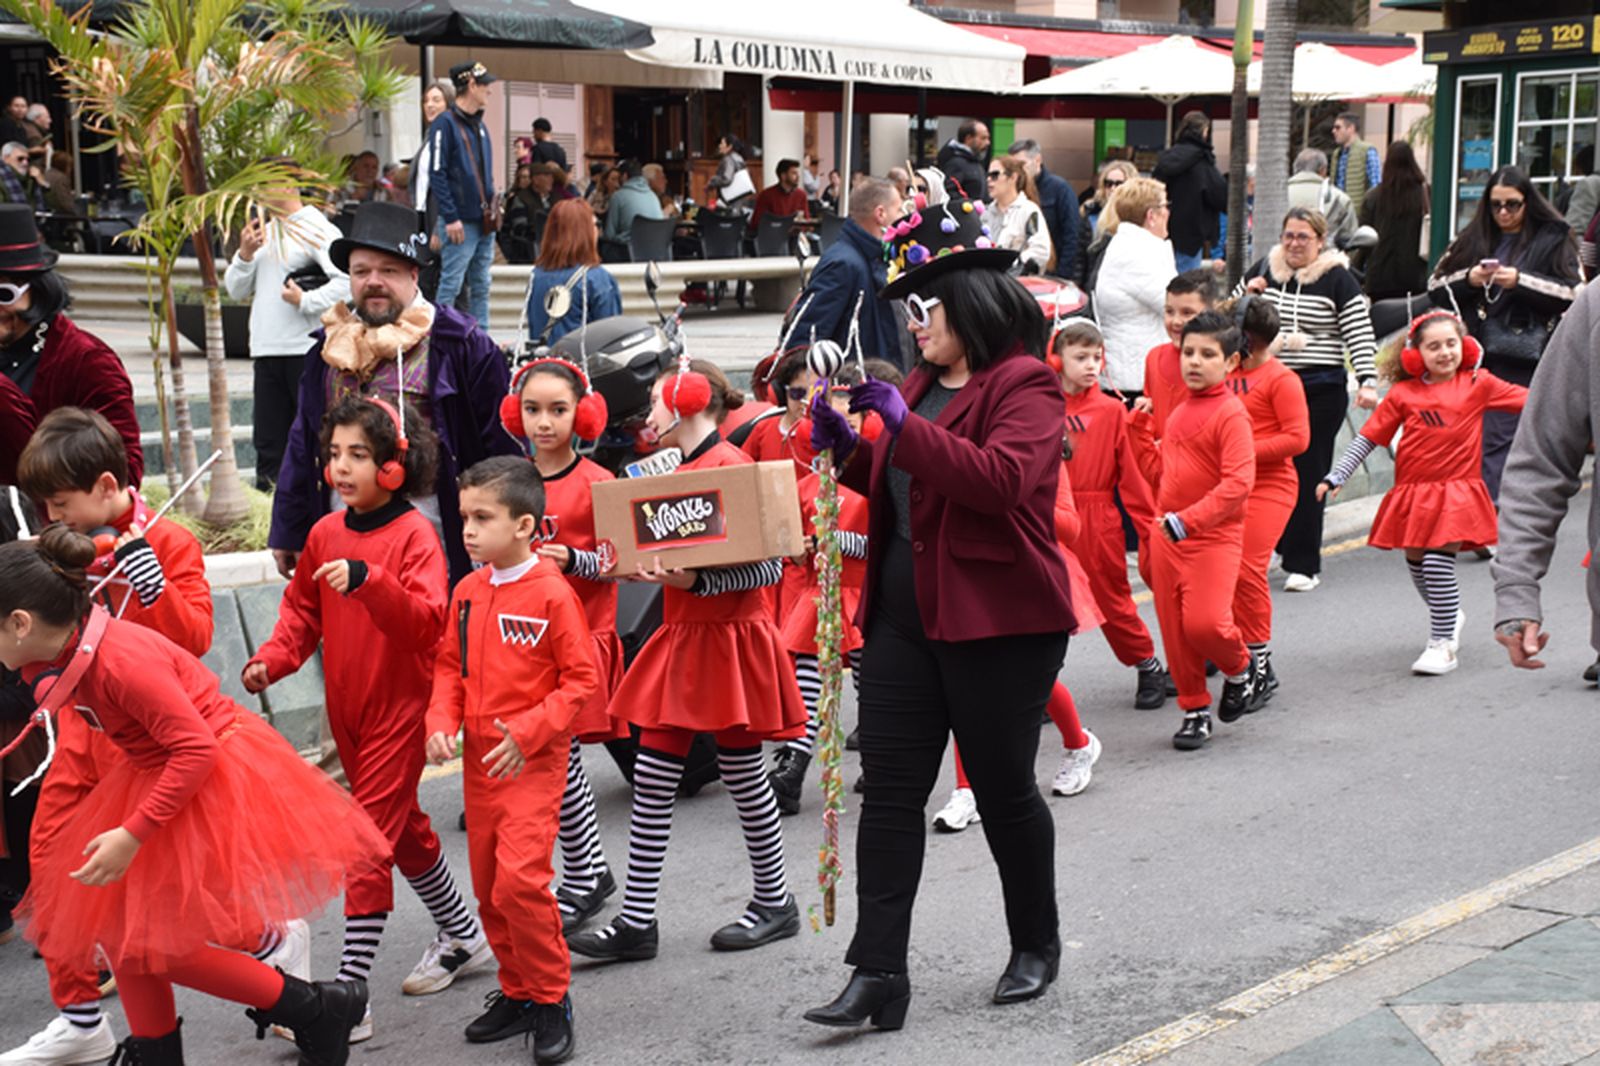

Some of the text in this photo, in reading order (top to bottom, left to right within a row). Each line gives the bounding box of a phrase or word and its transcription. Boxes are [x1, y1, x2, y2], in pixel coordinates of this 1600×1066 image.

[1551, 24, 1584, 43] 120
[694, 37, 933, 81] LA COLUMNA CAFE & COPAS
[646, 497, 713, 540] WONKA
